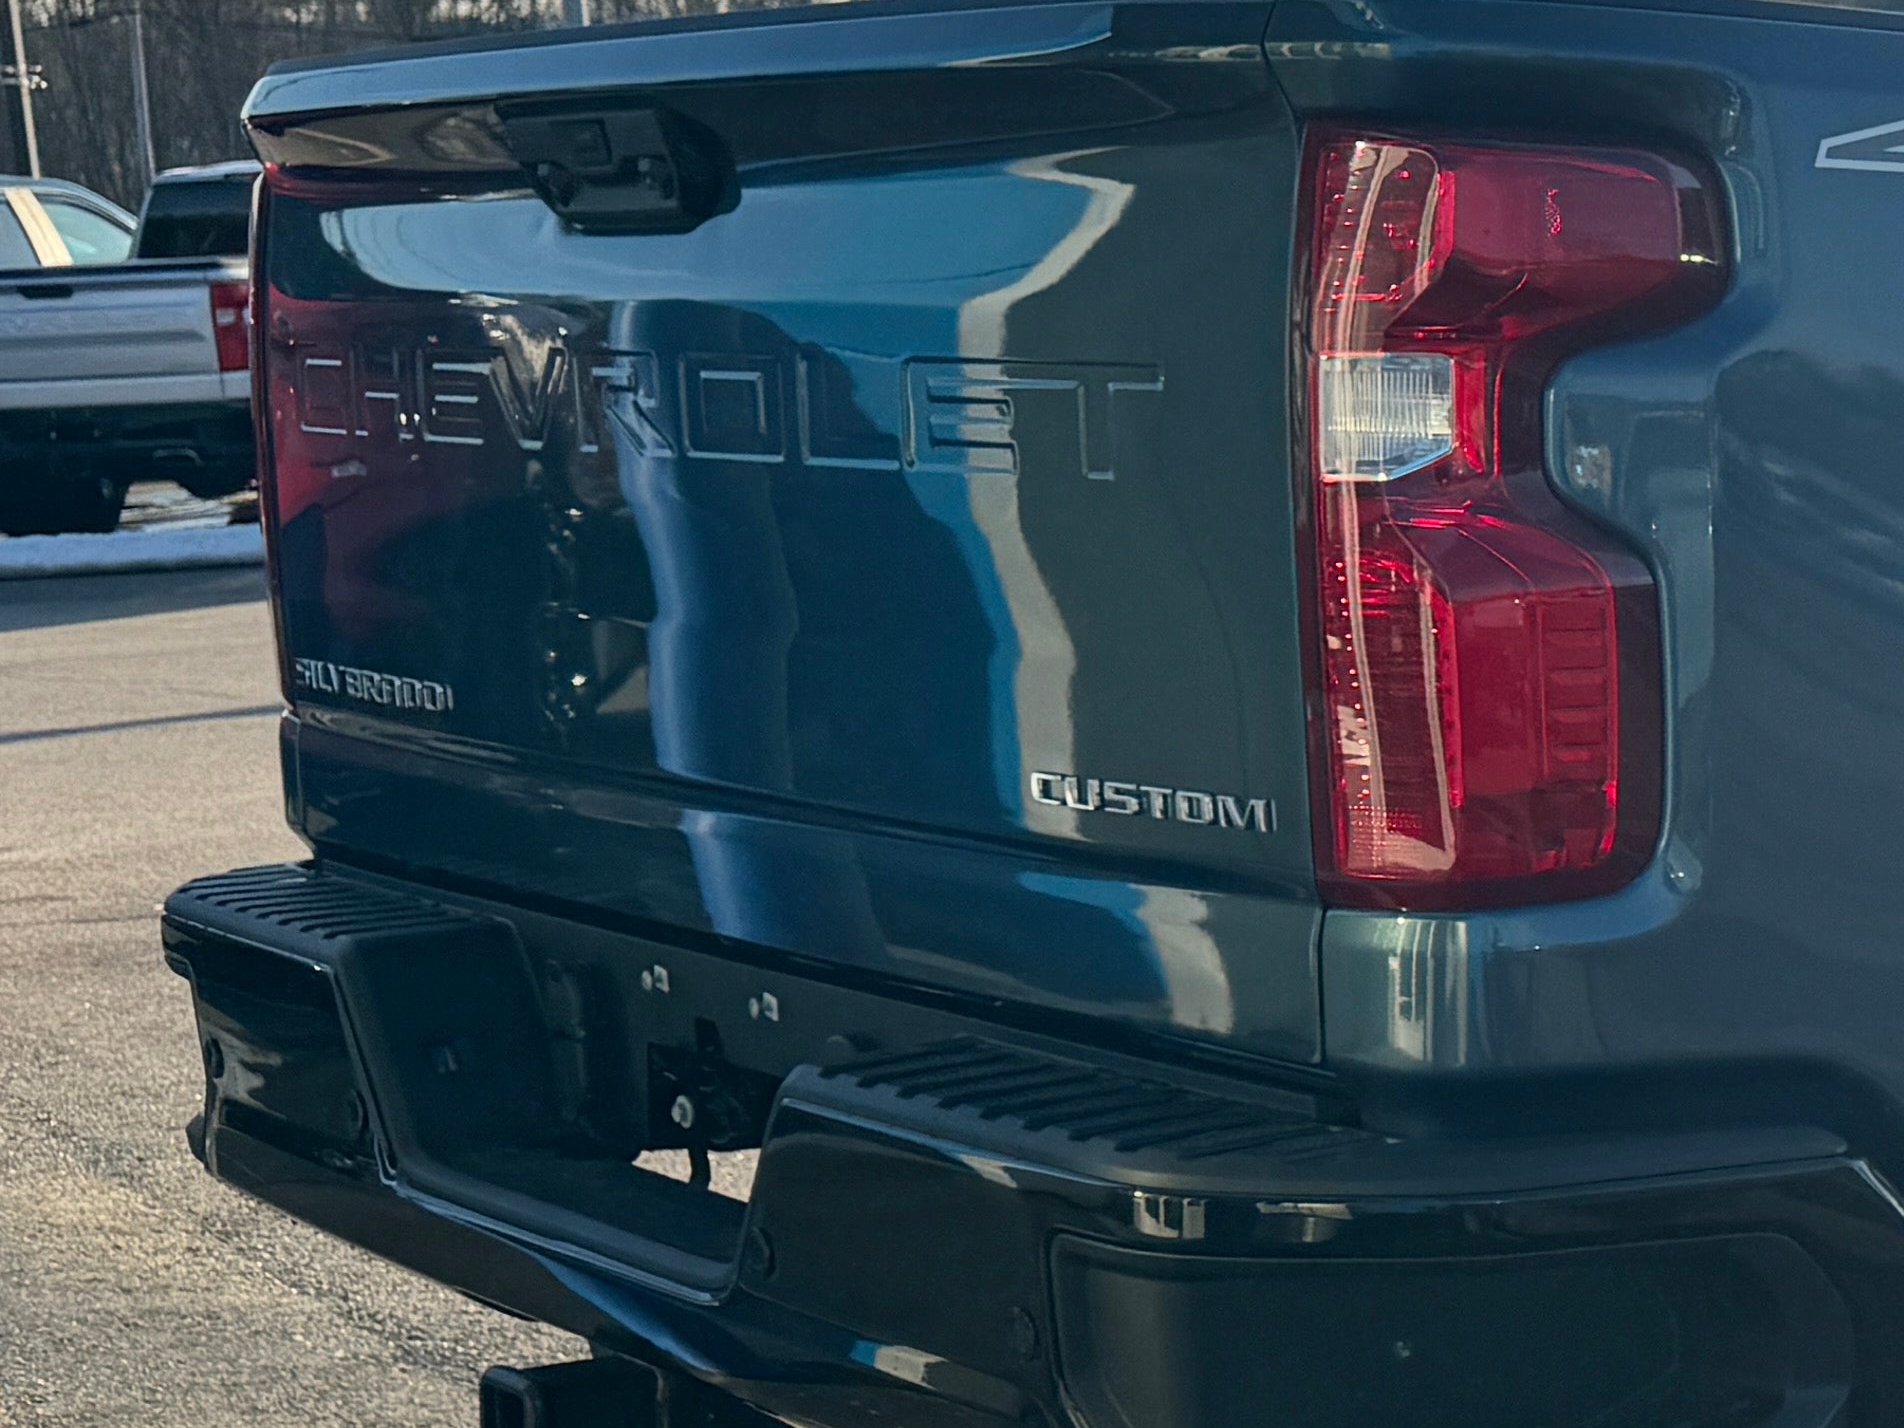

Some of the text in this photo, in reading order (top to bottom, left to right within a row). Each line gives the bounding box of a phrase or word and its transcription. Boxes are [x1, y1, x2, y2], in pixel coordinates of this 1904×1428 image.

[298, 342, 1165, 481] CHEVROLET
[295, 657, 454, 712] SILVERADO
[1031, 771, 1277, 833] CUSTOM
